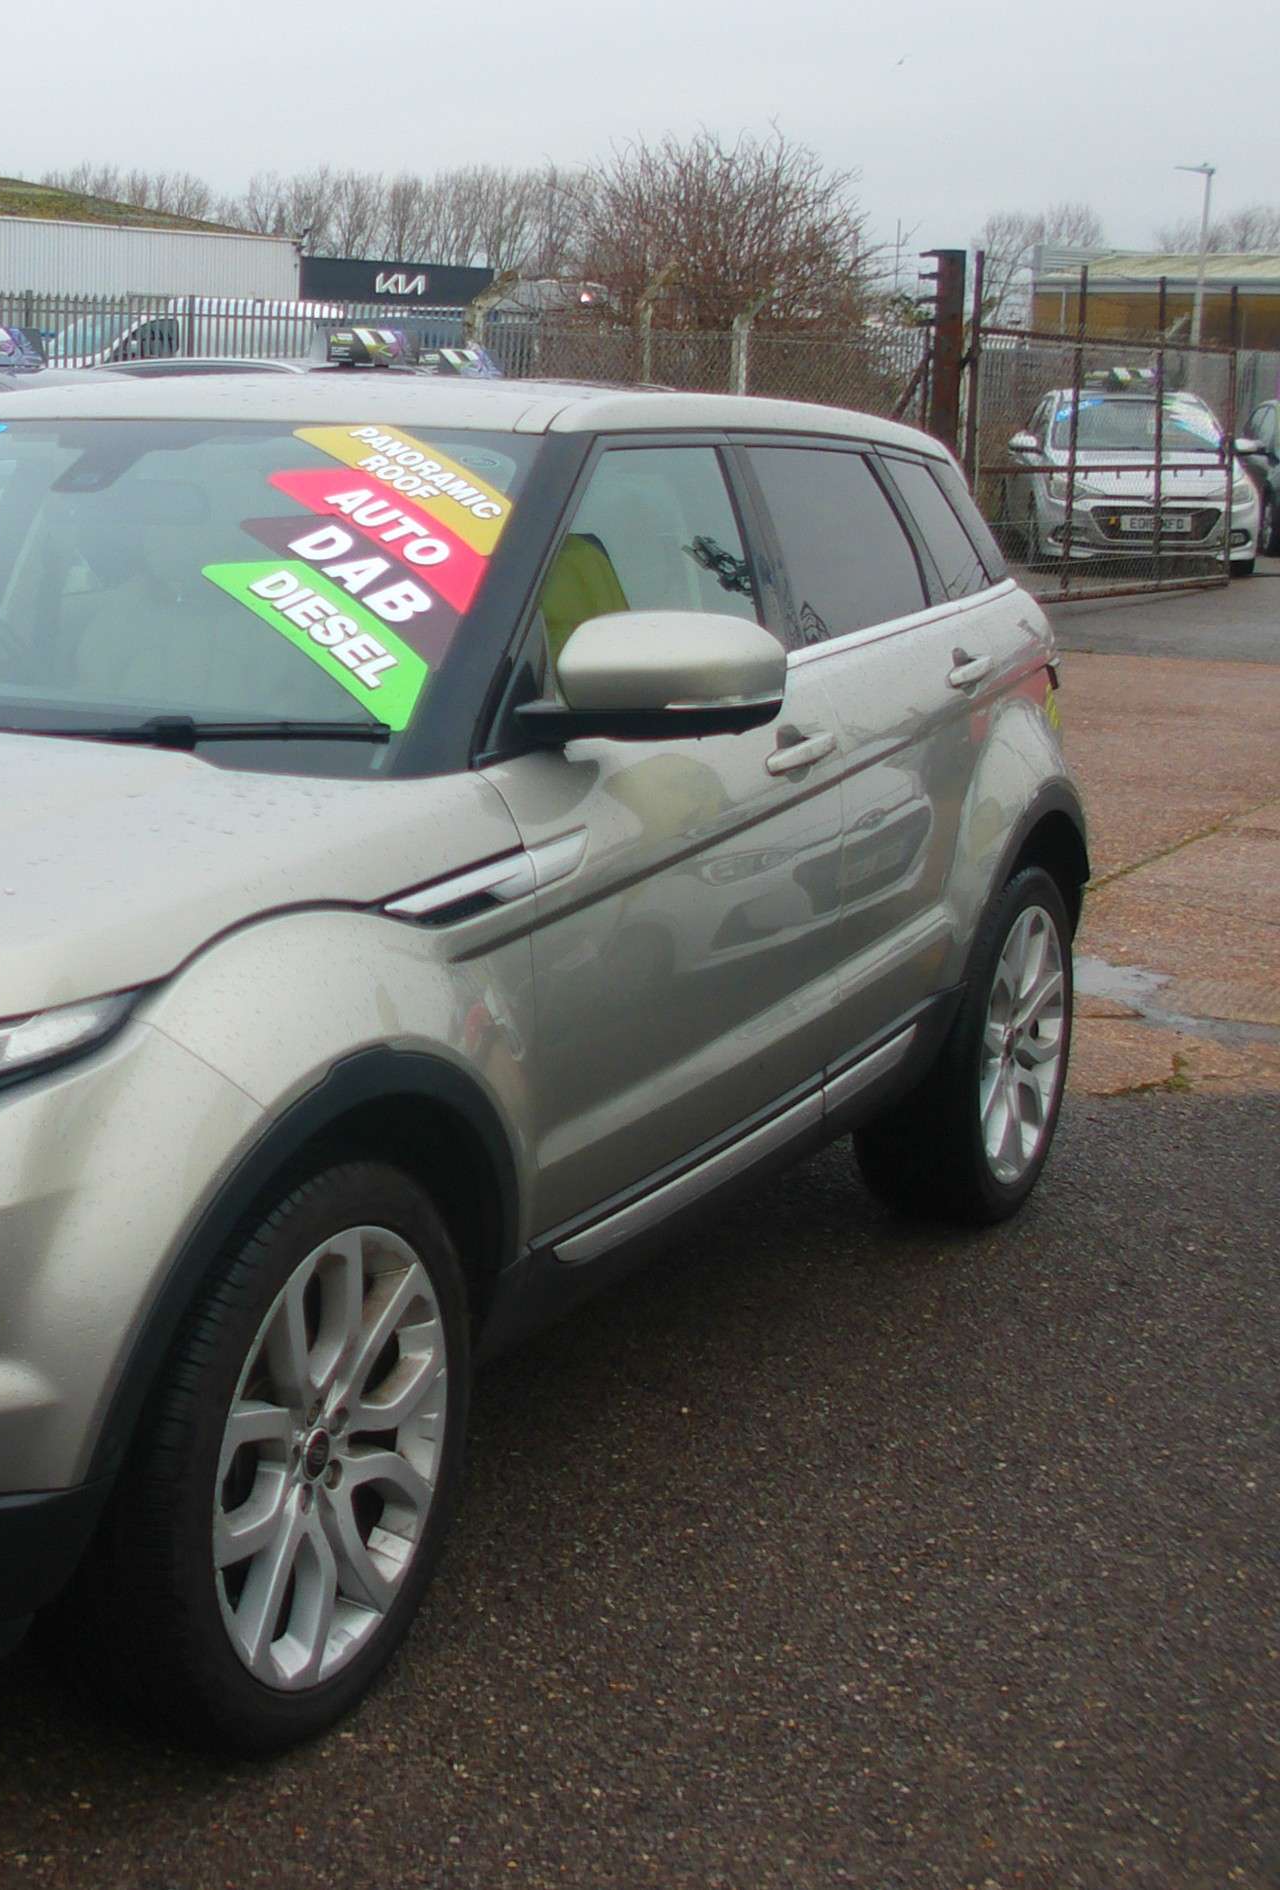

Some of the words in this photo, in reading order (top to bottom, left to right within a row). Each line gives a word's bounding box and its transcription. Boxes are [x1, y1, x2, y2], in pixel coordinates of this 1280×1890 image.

[375, 272, 426, 296] KIA
[349, 426, 502, 519] PANORAMIC
[357, 454, 441, 498] ROOF
[323, 488, 451, 566] AUTO
[287, 525, 432, 622] DAB
[247, 570, 399, 690] DIESEL
